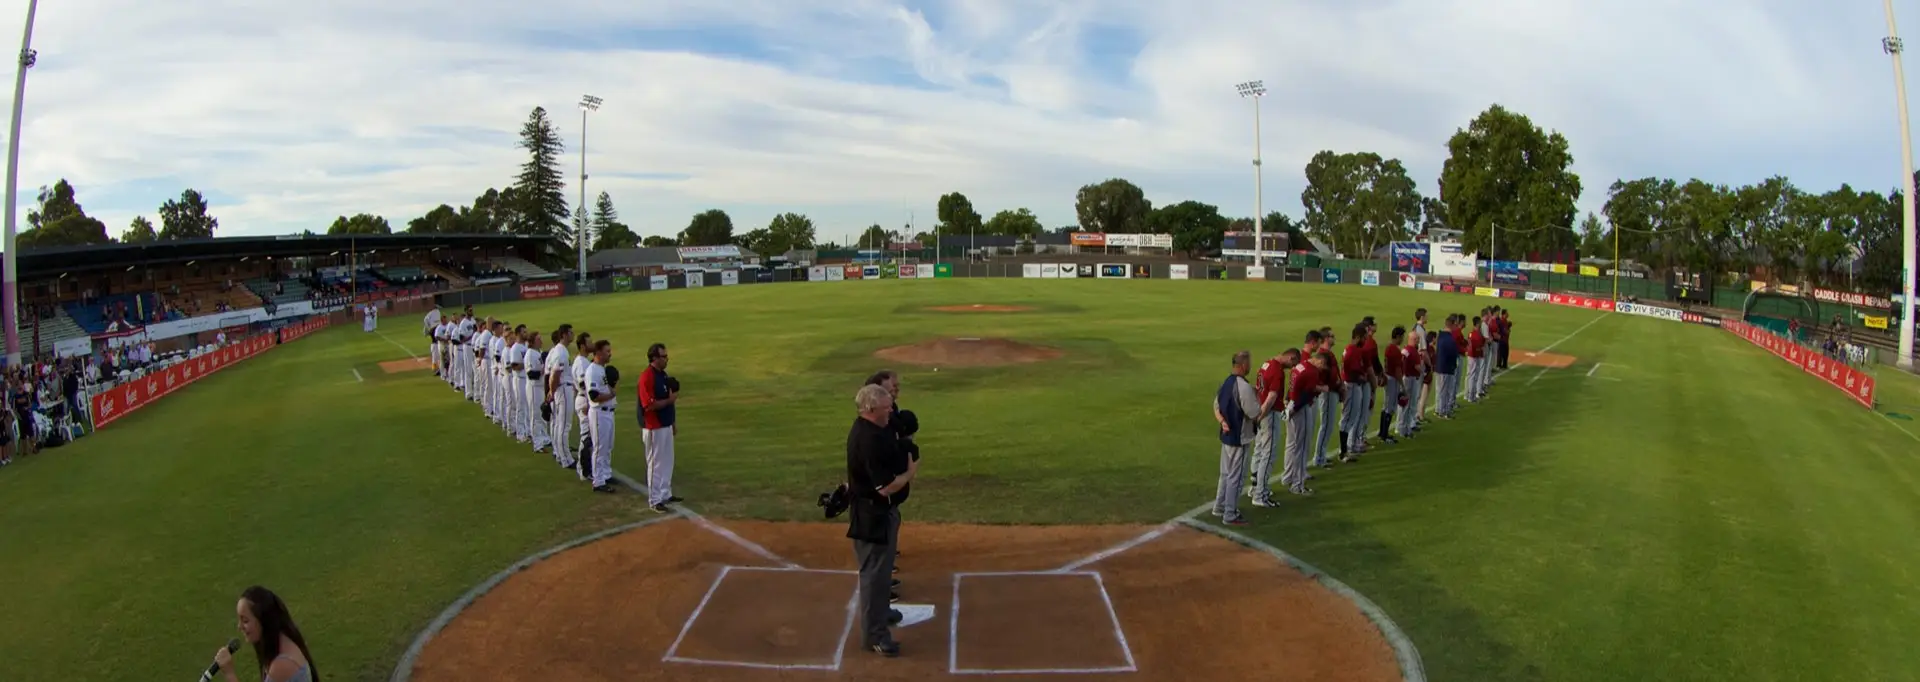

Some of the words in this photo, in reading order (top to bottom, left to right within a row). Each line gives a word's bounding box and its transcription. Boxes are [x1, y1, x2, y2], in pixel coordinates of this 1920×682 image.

[545, 283, 559, 291] Bank
[1814, 288, 1840, 301] CADDLE
[1841, 292, 1863, 305] CRASH
[1633, 304, 1648, 313] VIV
[1649, 306, 1682, 319] SPORTS
